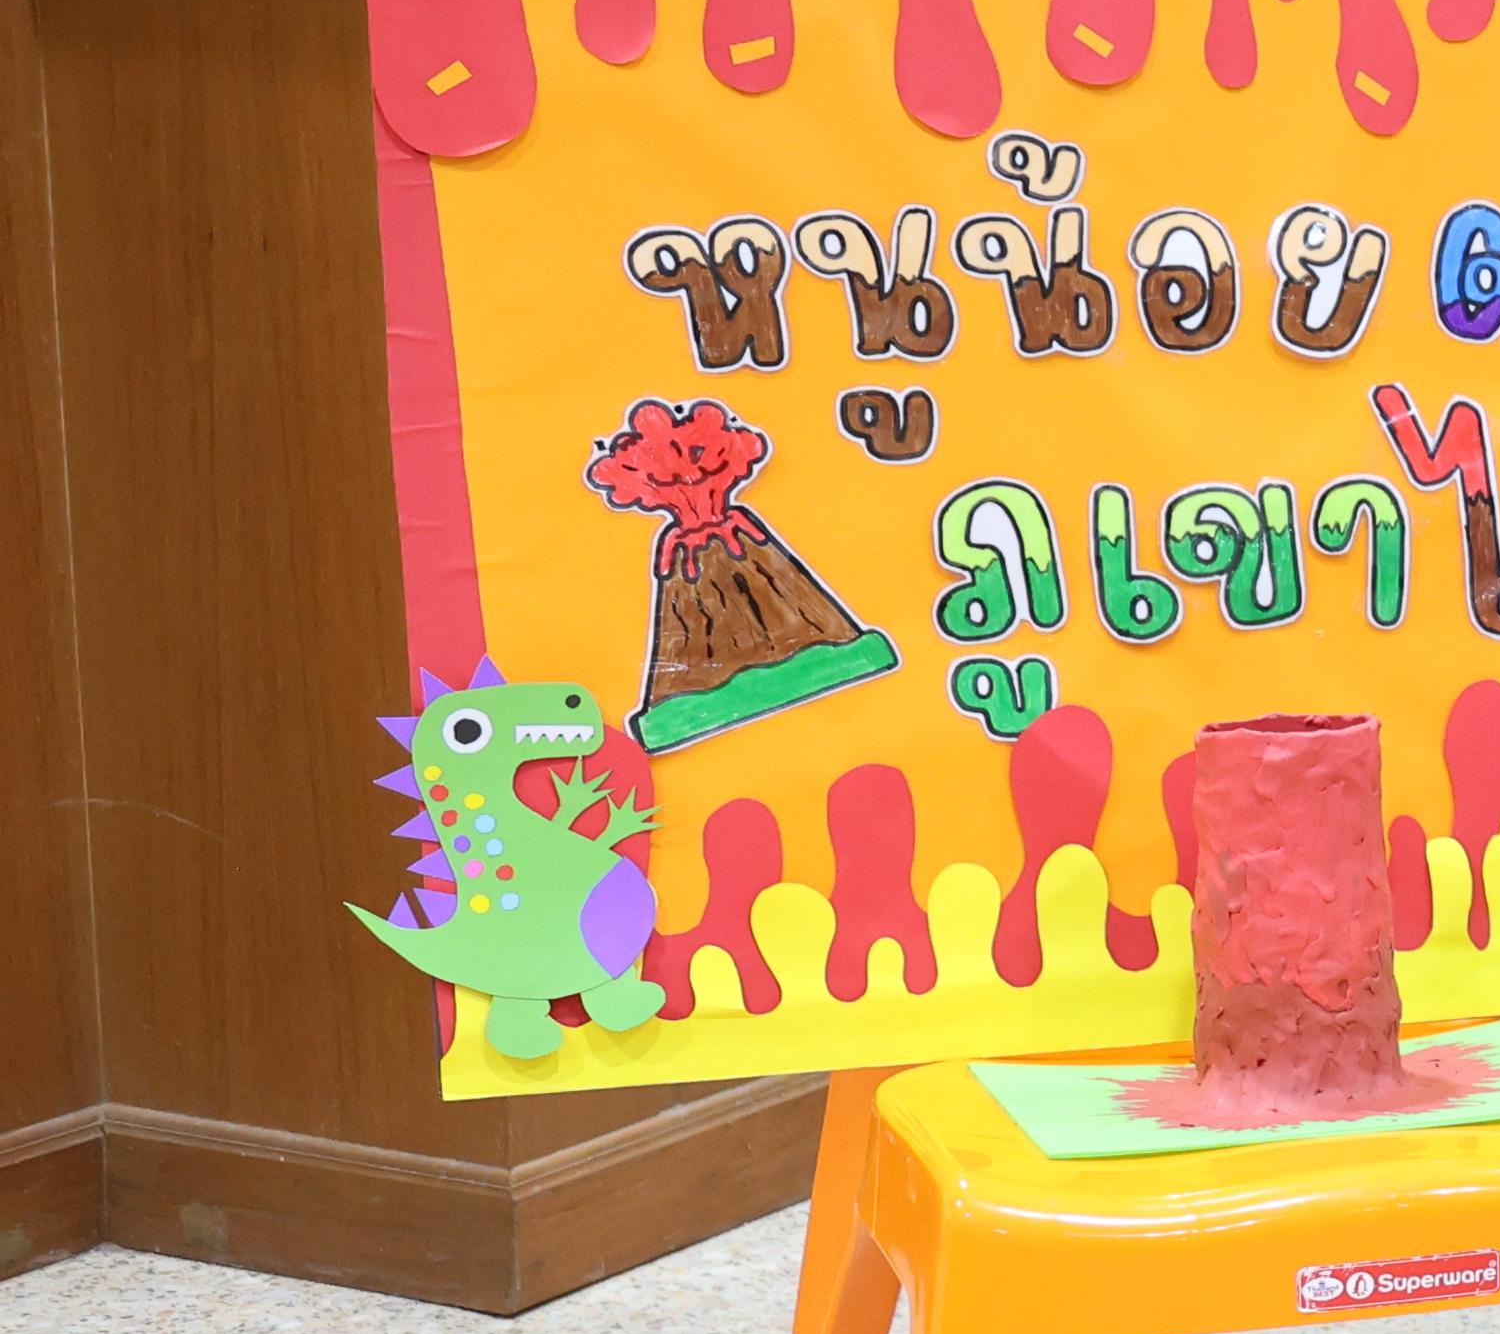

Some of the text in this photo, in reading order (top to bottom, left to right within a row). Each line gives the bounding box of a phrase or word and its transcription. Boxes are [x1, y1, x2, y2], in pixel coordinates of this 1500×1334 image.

[630, 132, 1388, 461] หนูน้อย
[1378, 1266, 1496, 1294] Superware
